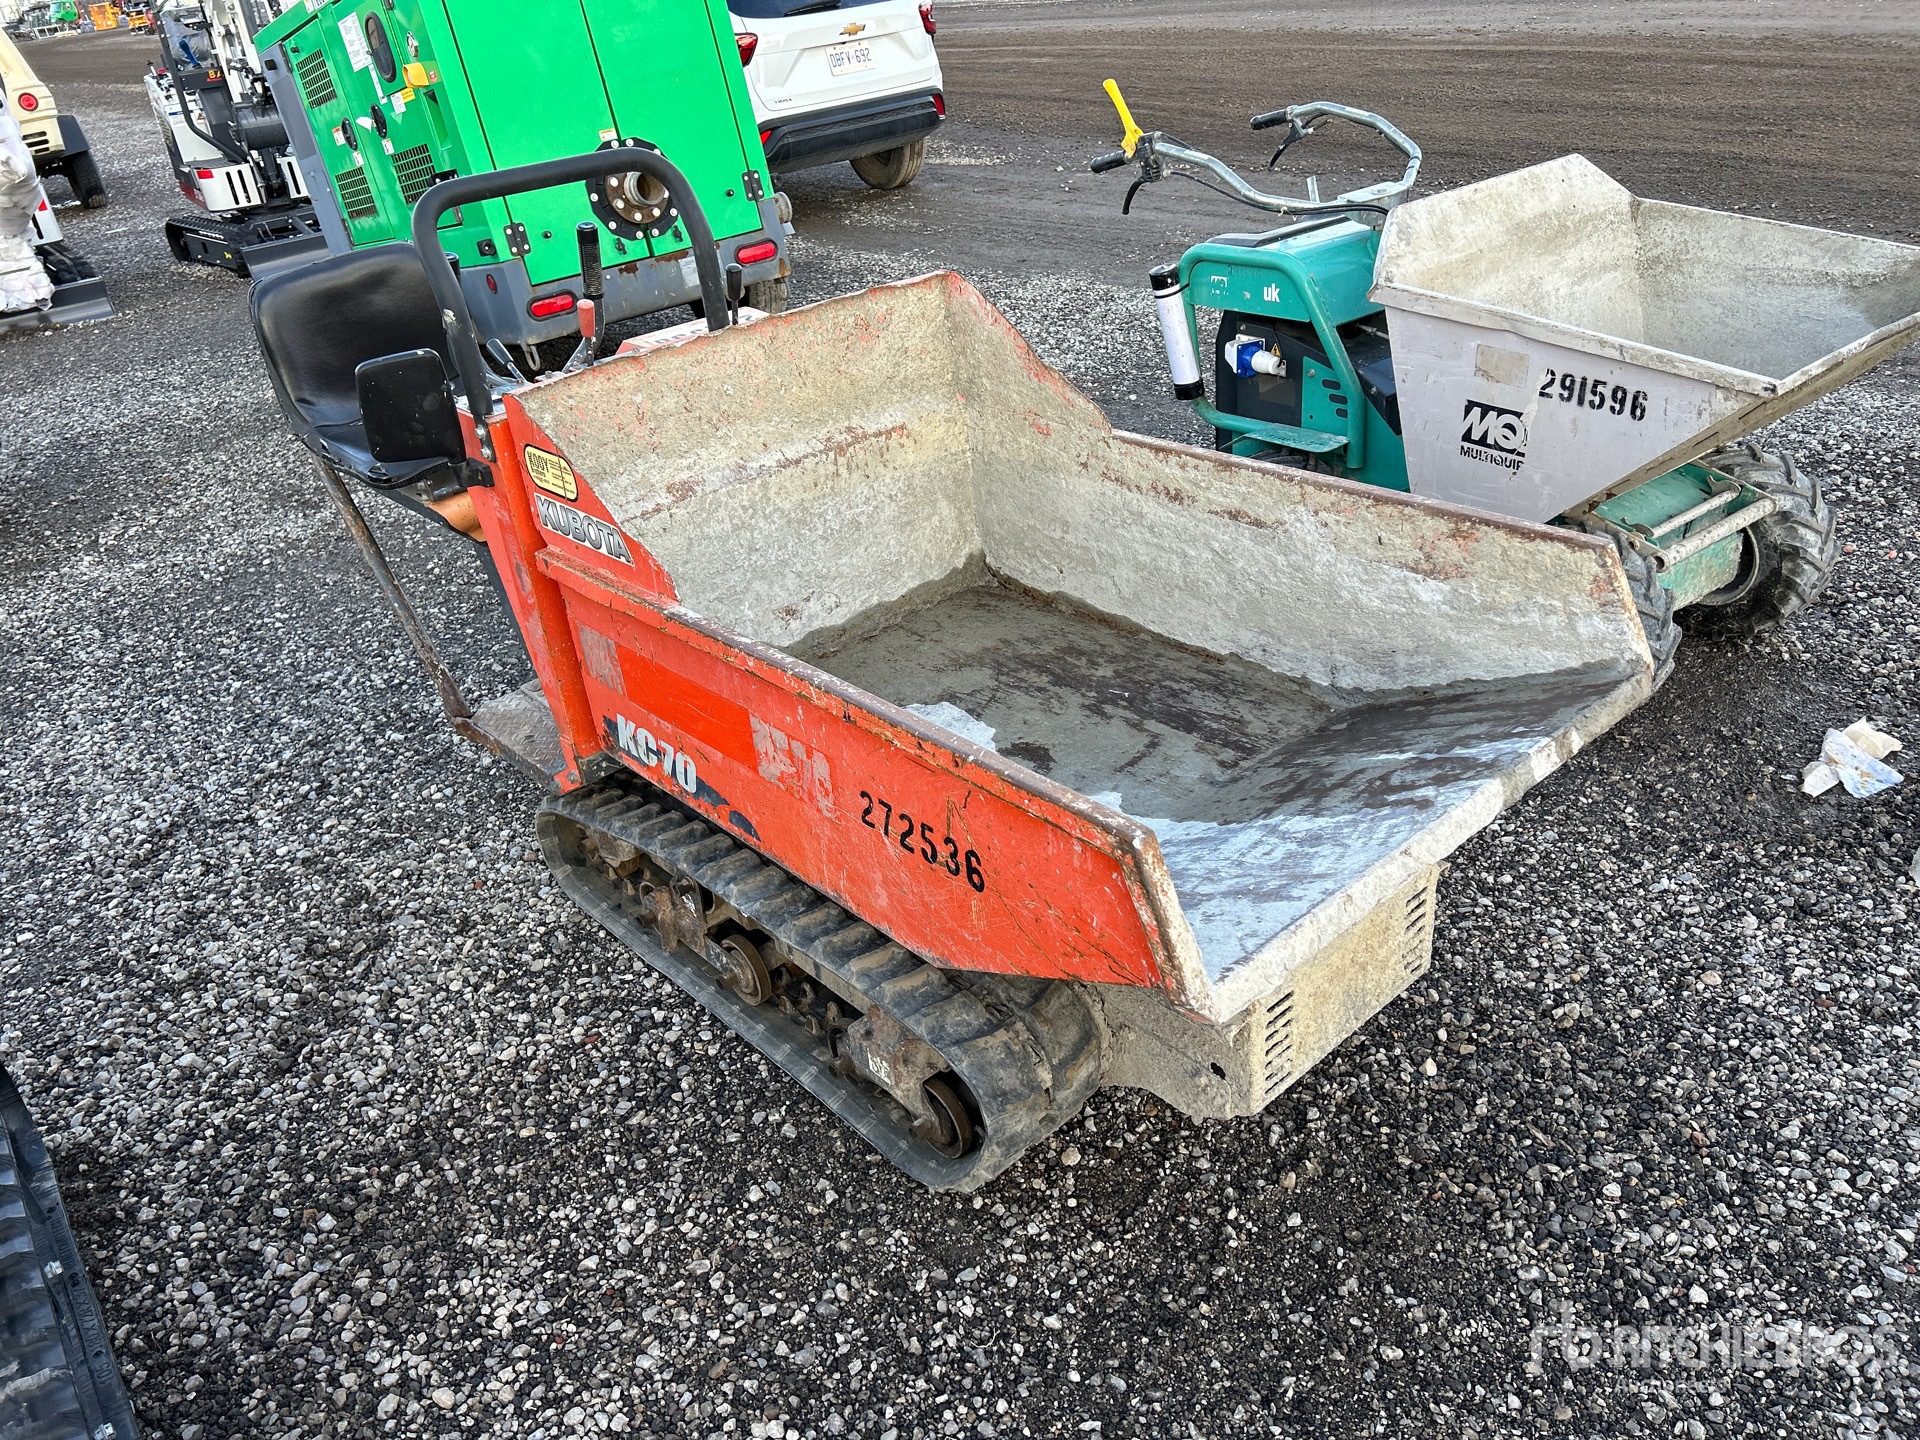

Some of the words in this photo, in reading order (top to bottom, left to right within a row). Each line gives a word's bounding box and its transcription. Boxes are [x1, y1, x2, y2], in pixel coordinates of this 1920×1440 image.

[1263, 283, 1281, 303] uk
[1538, 368, 1649, 422] 291596
[535, 494, 633, 564] KUBOTA
[616, 712, 697, 794] KC70
[859, 790, 986, 893] 272536
